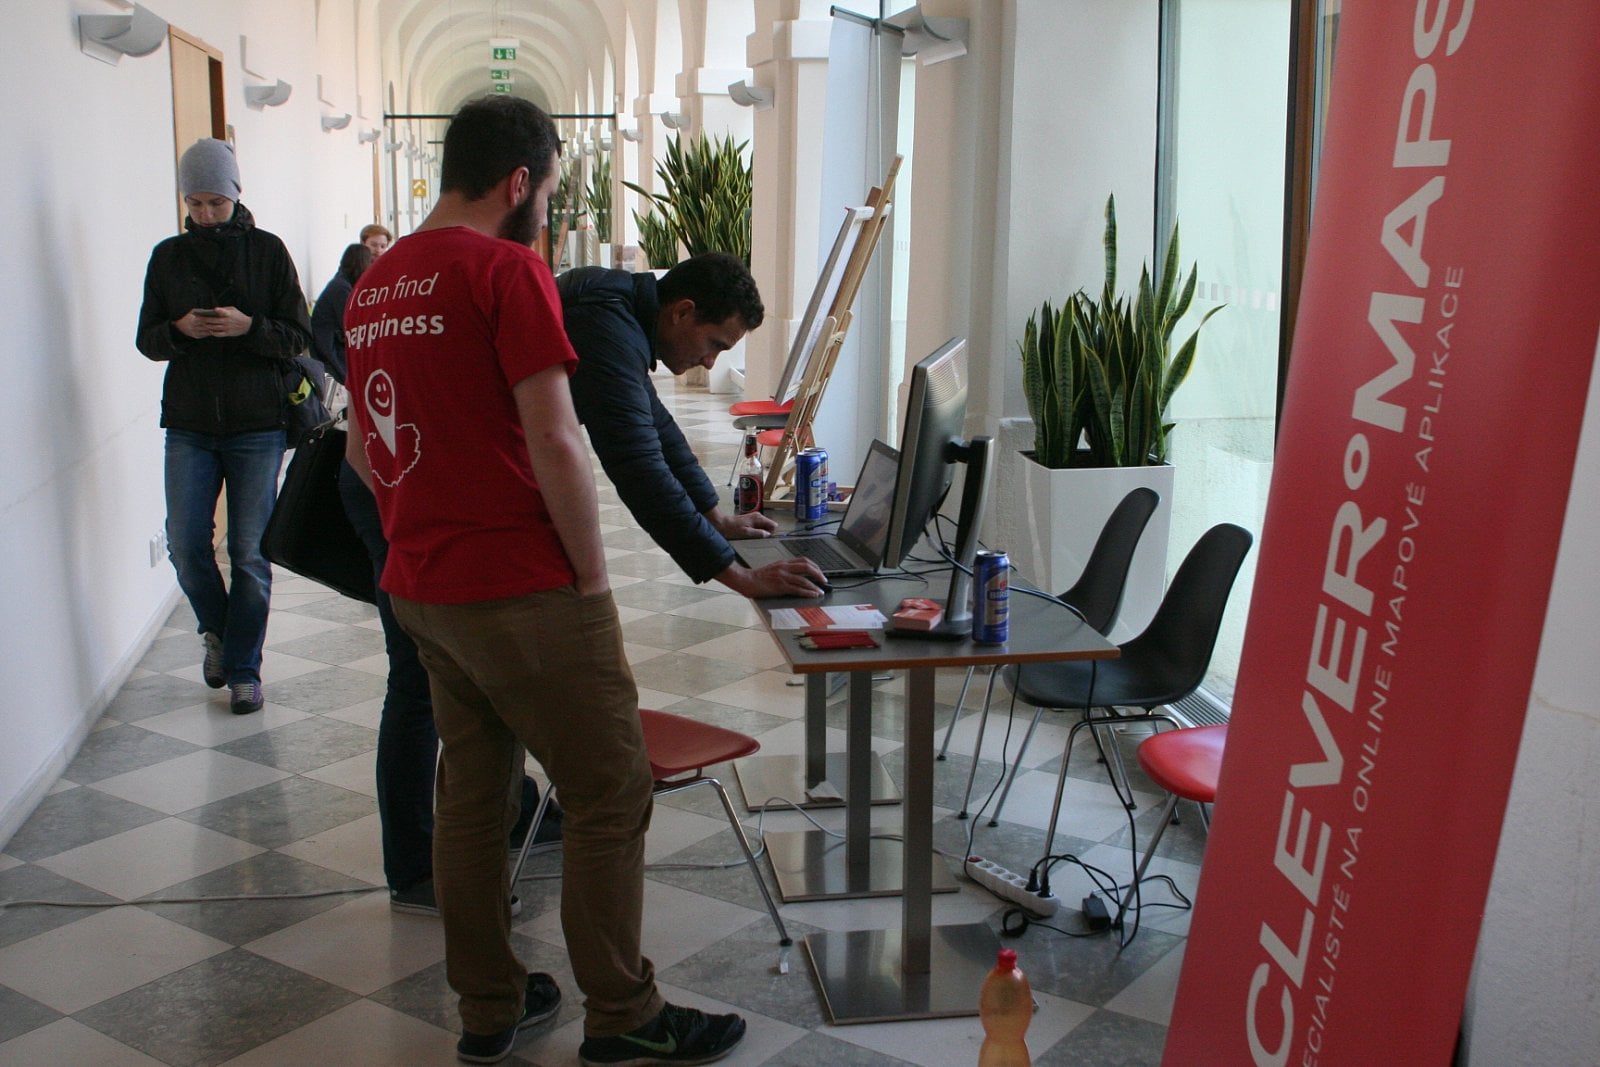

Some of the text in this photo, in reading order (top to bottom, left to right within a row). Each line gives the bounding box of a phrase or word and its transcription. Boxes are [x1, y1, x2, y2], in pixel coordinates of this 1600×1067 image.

[349, 272, 439, 310] I can find
[1340, 827, 1362, 880] NA
[1352, 665, 1392, 813] ONLINE
[1381, 481, 1426, 656] MAPOVÉ
[1414, 266, 1464, 472] APLIKACE
